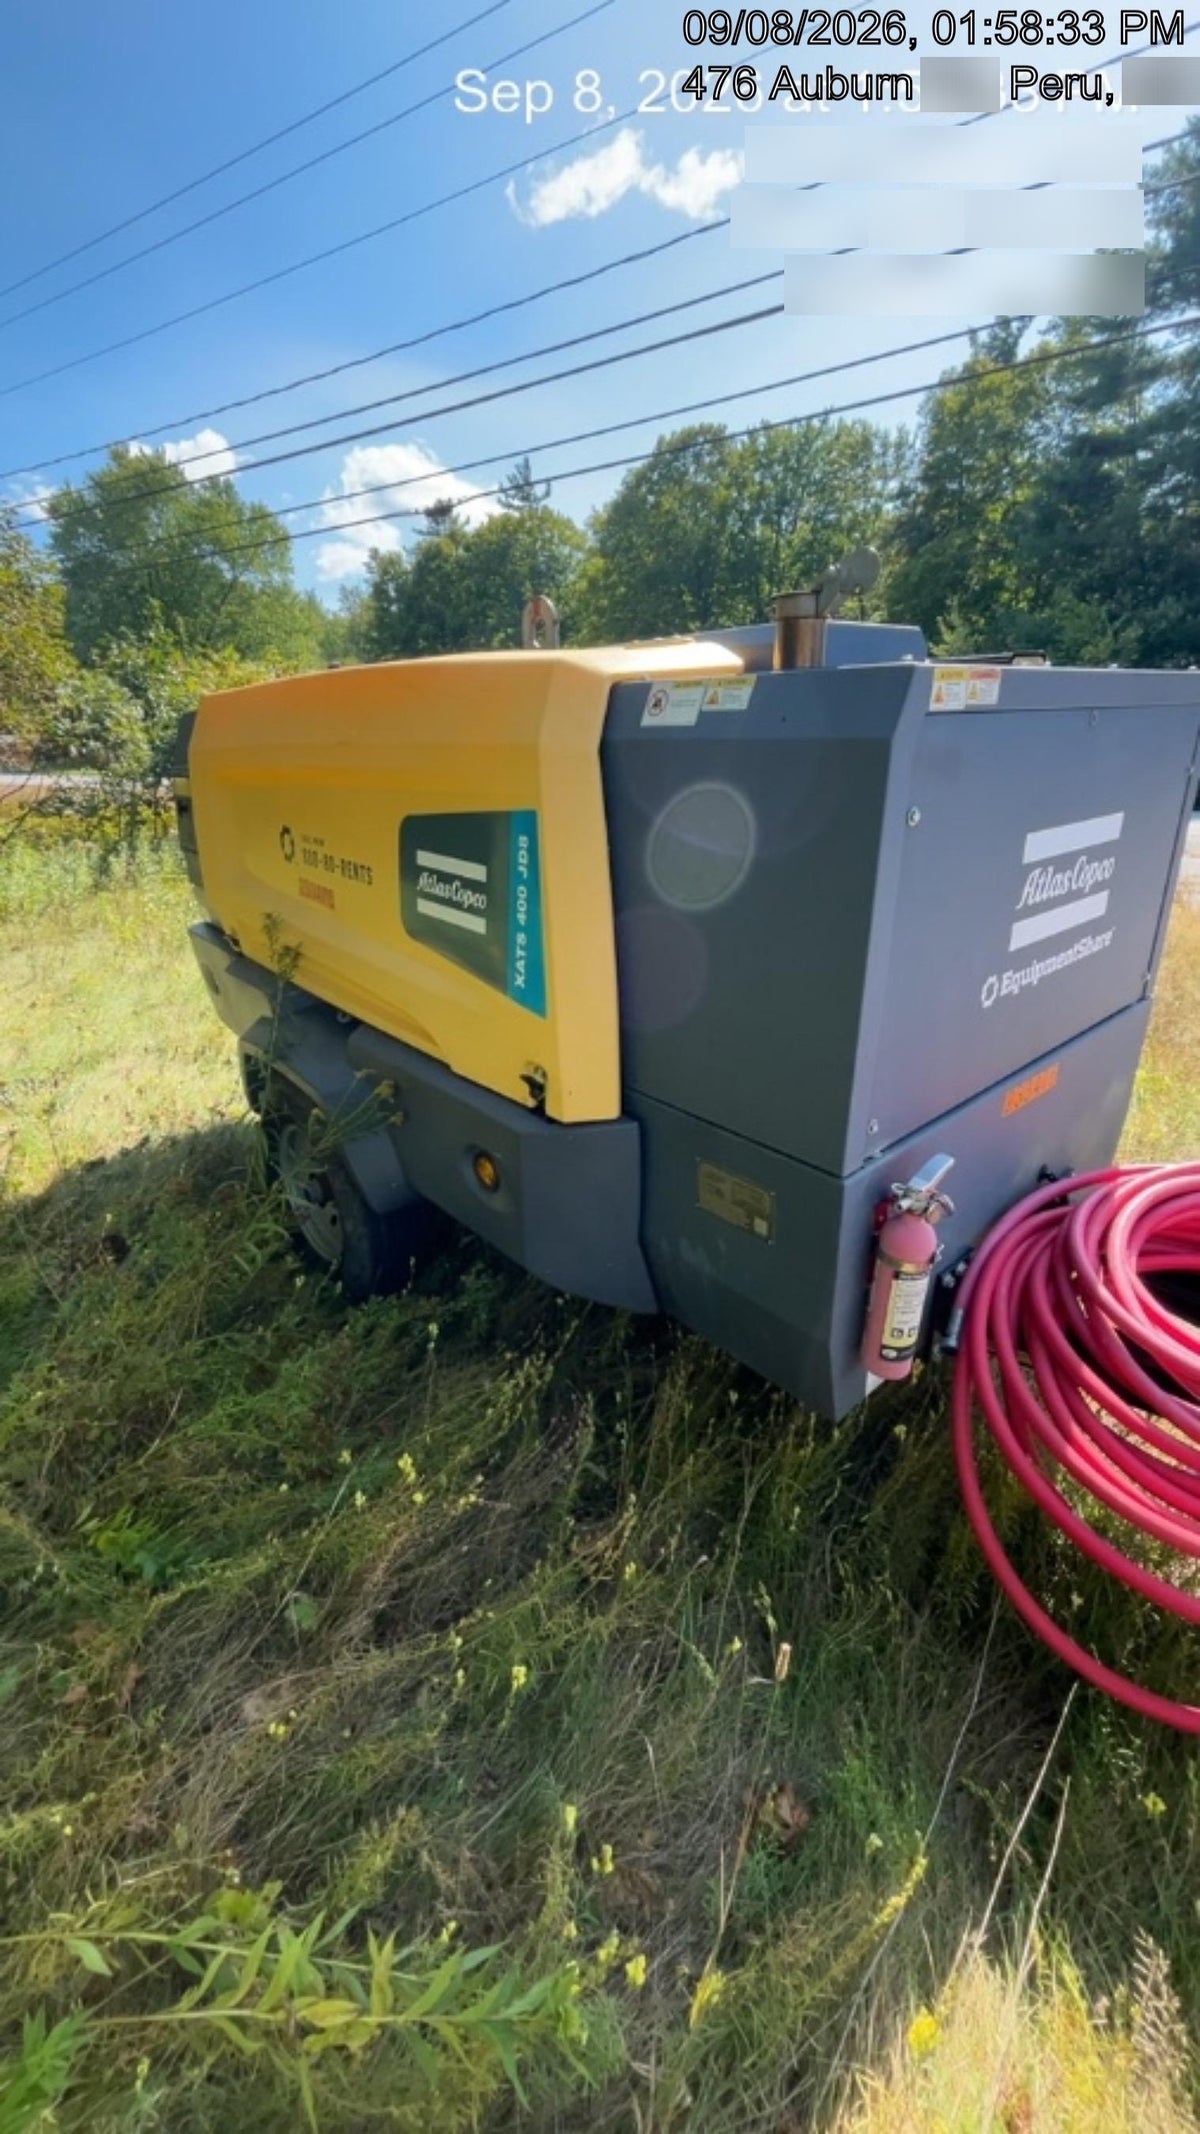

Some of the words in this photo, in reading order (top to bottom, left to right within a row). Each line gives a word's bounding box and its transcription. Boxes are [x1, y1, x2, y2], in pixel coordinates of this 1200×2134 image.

[416, 871, 451, 899] Atlas
[452, 880, 487, 909] Copco
[516, 886, 528, 926] 400
[1015, 866, 1072, 910] Atlas
[1071, 855, 1116, 893] Copco
[514, 932, 528, 989] XATS
[1000, 931, 1114, 996] EquipmentShare
